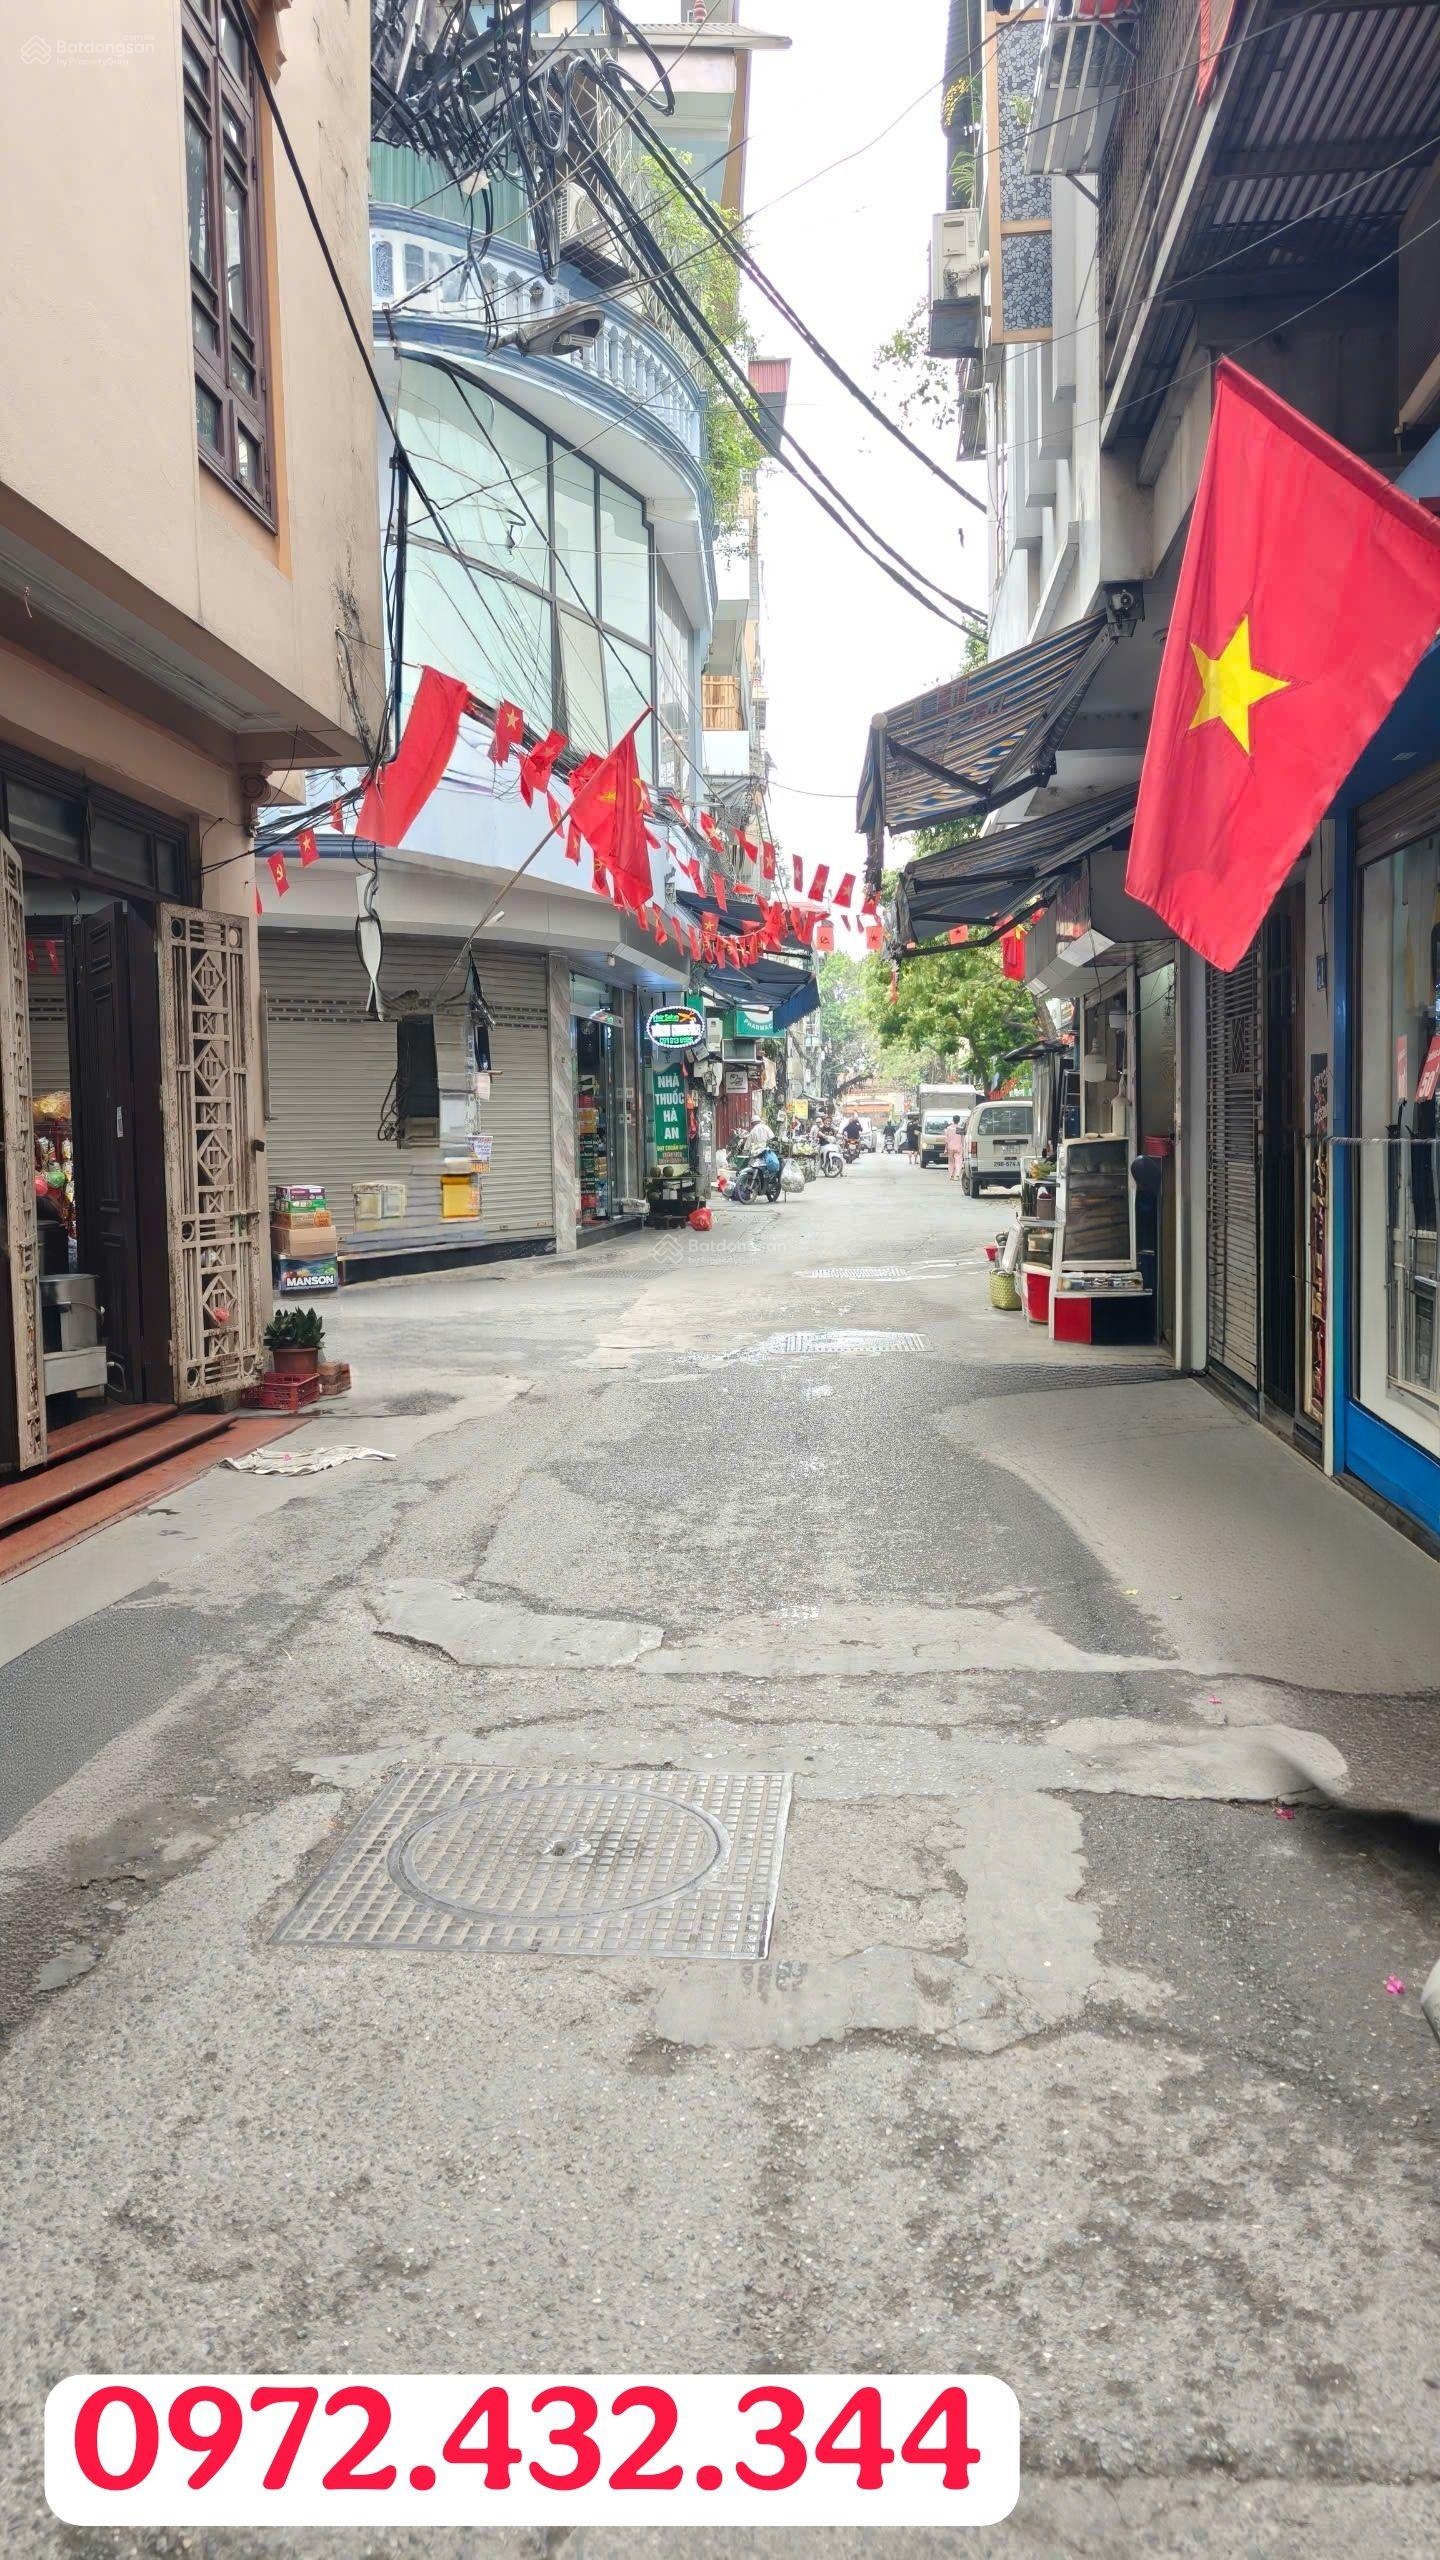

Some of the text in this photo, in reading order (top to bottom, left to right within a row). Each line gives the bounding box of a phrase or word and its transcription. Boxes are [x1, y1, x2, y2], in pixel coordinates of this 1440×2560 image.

[743, 1019, 773, 1031] PHARMAC
[657, 1073, 679, 1088] NHÀ
[654, 1088, 684, 1105] THUỐC
[663, 1107, 677, 1122] HÀ
[664, 1127, 679, 1139] AN
[286, 1275, 334, 1287] MANSON
